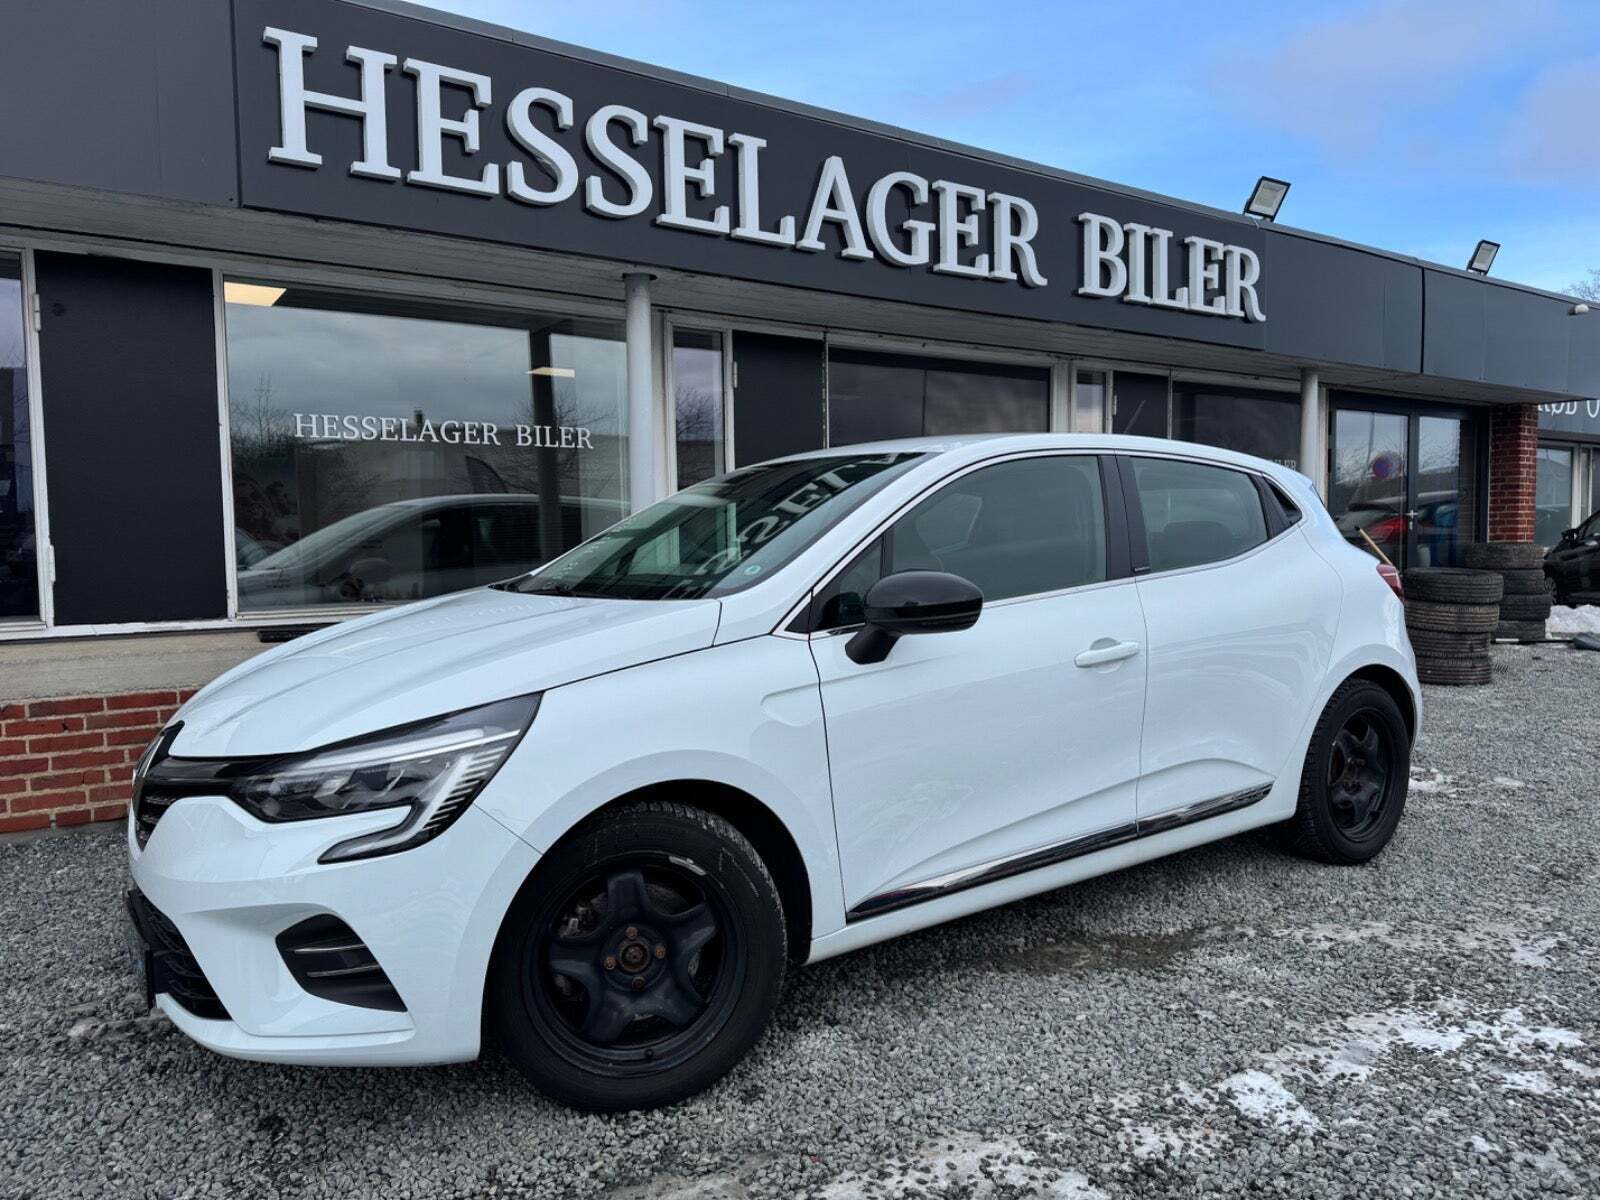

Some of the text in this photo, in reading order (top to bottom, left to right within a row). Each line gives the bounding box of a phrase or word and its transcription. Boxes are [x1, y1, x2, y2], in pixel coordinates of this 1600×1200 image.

[263, 26, 1267, 322] HESSELAGER BILER
[293, 413, 594, 449] HESSELAGER BILER
